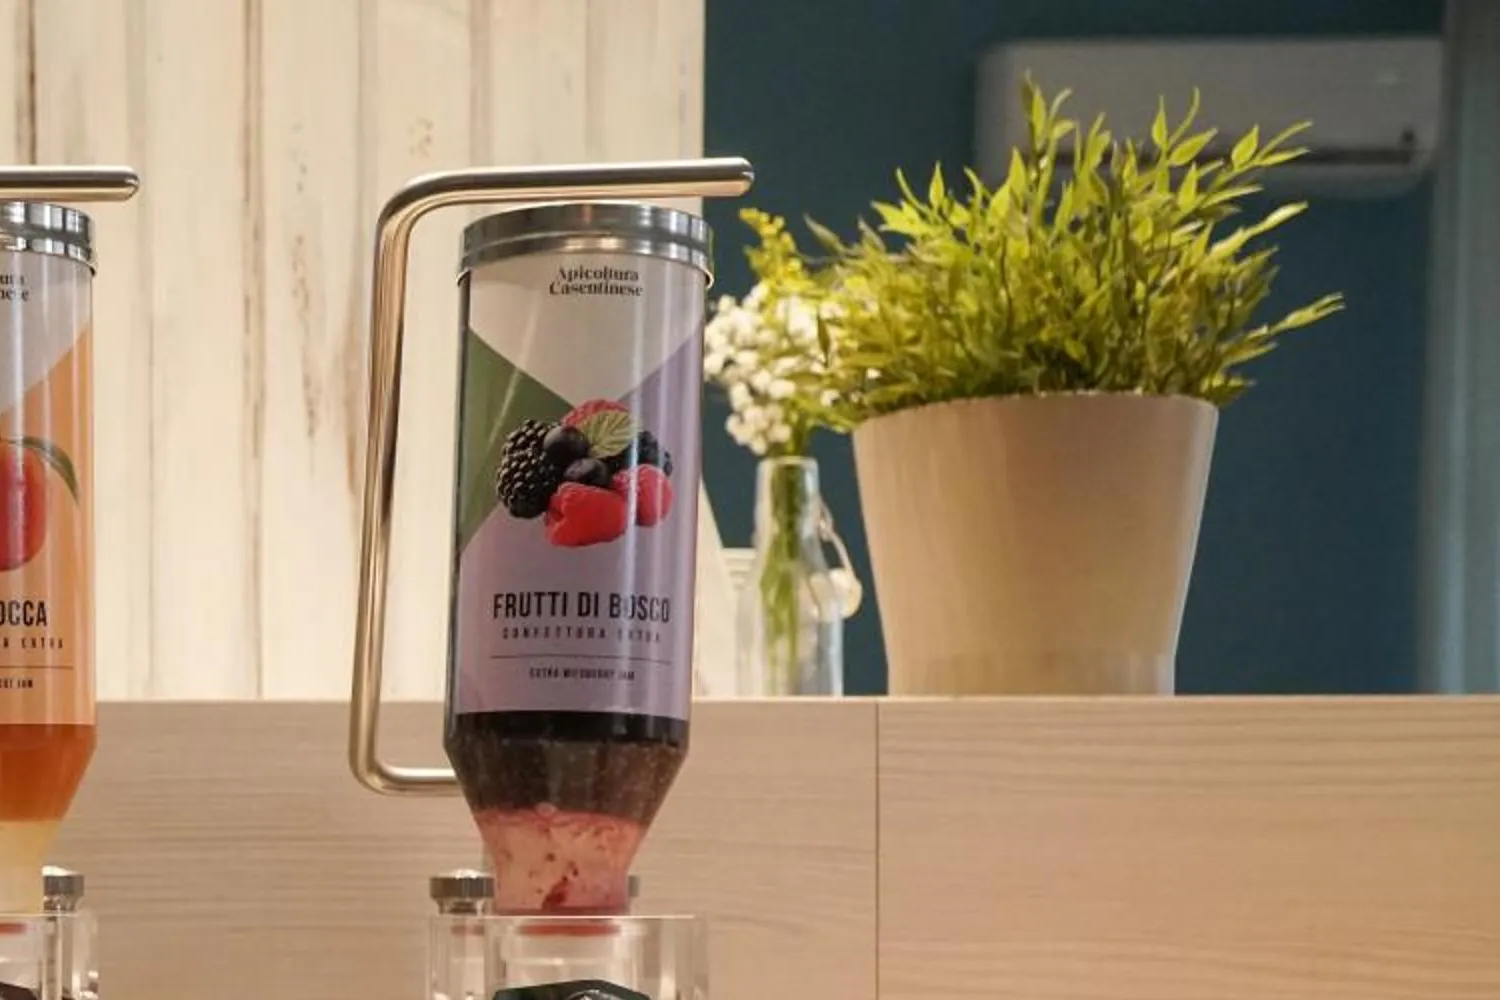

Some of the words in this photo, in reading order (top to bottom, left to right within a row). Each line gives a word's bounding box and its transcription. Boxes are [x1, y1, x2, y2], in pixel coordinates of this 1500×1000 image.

[493, 591, 568, 619] FRUTTI
[577, 592, 599, 618] DI
[609, 594, 671, 623] BOSCO
